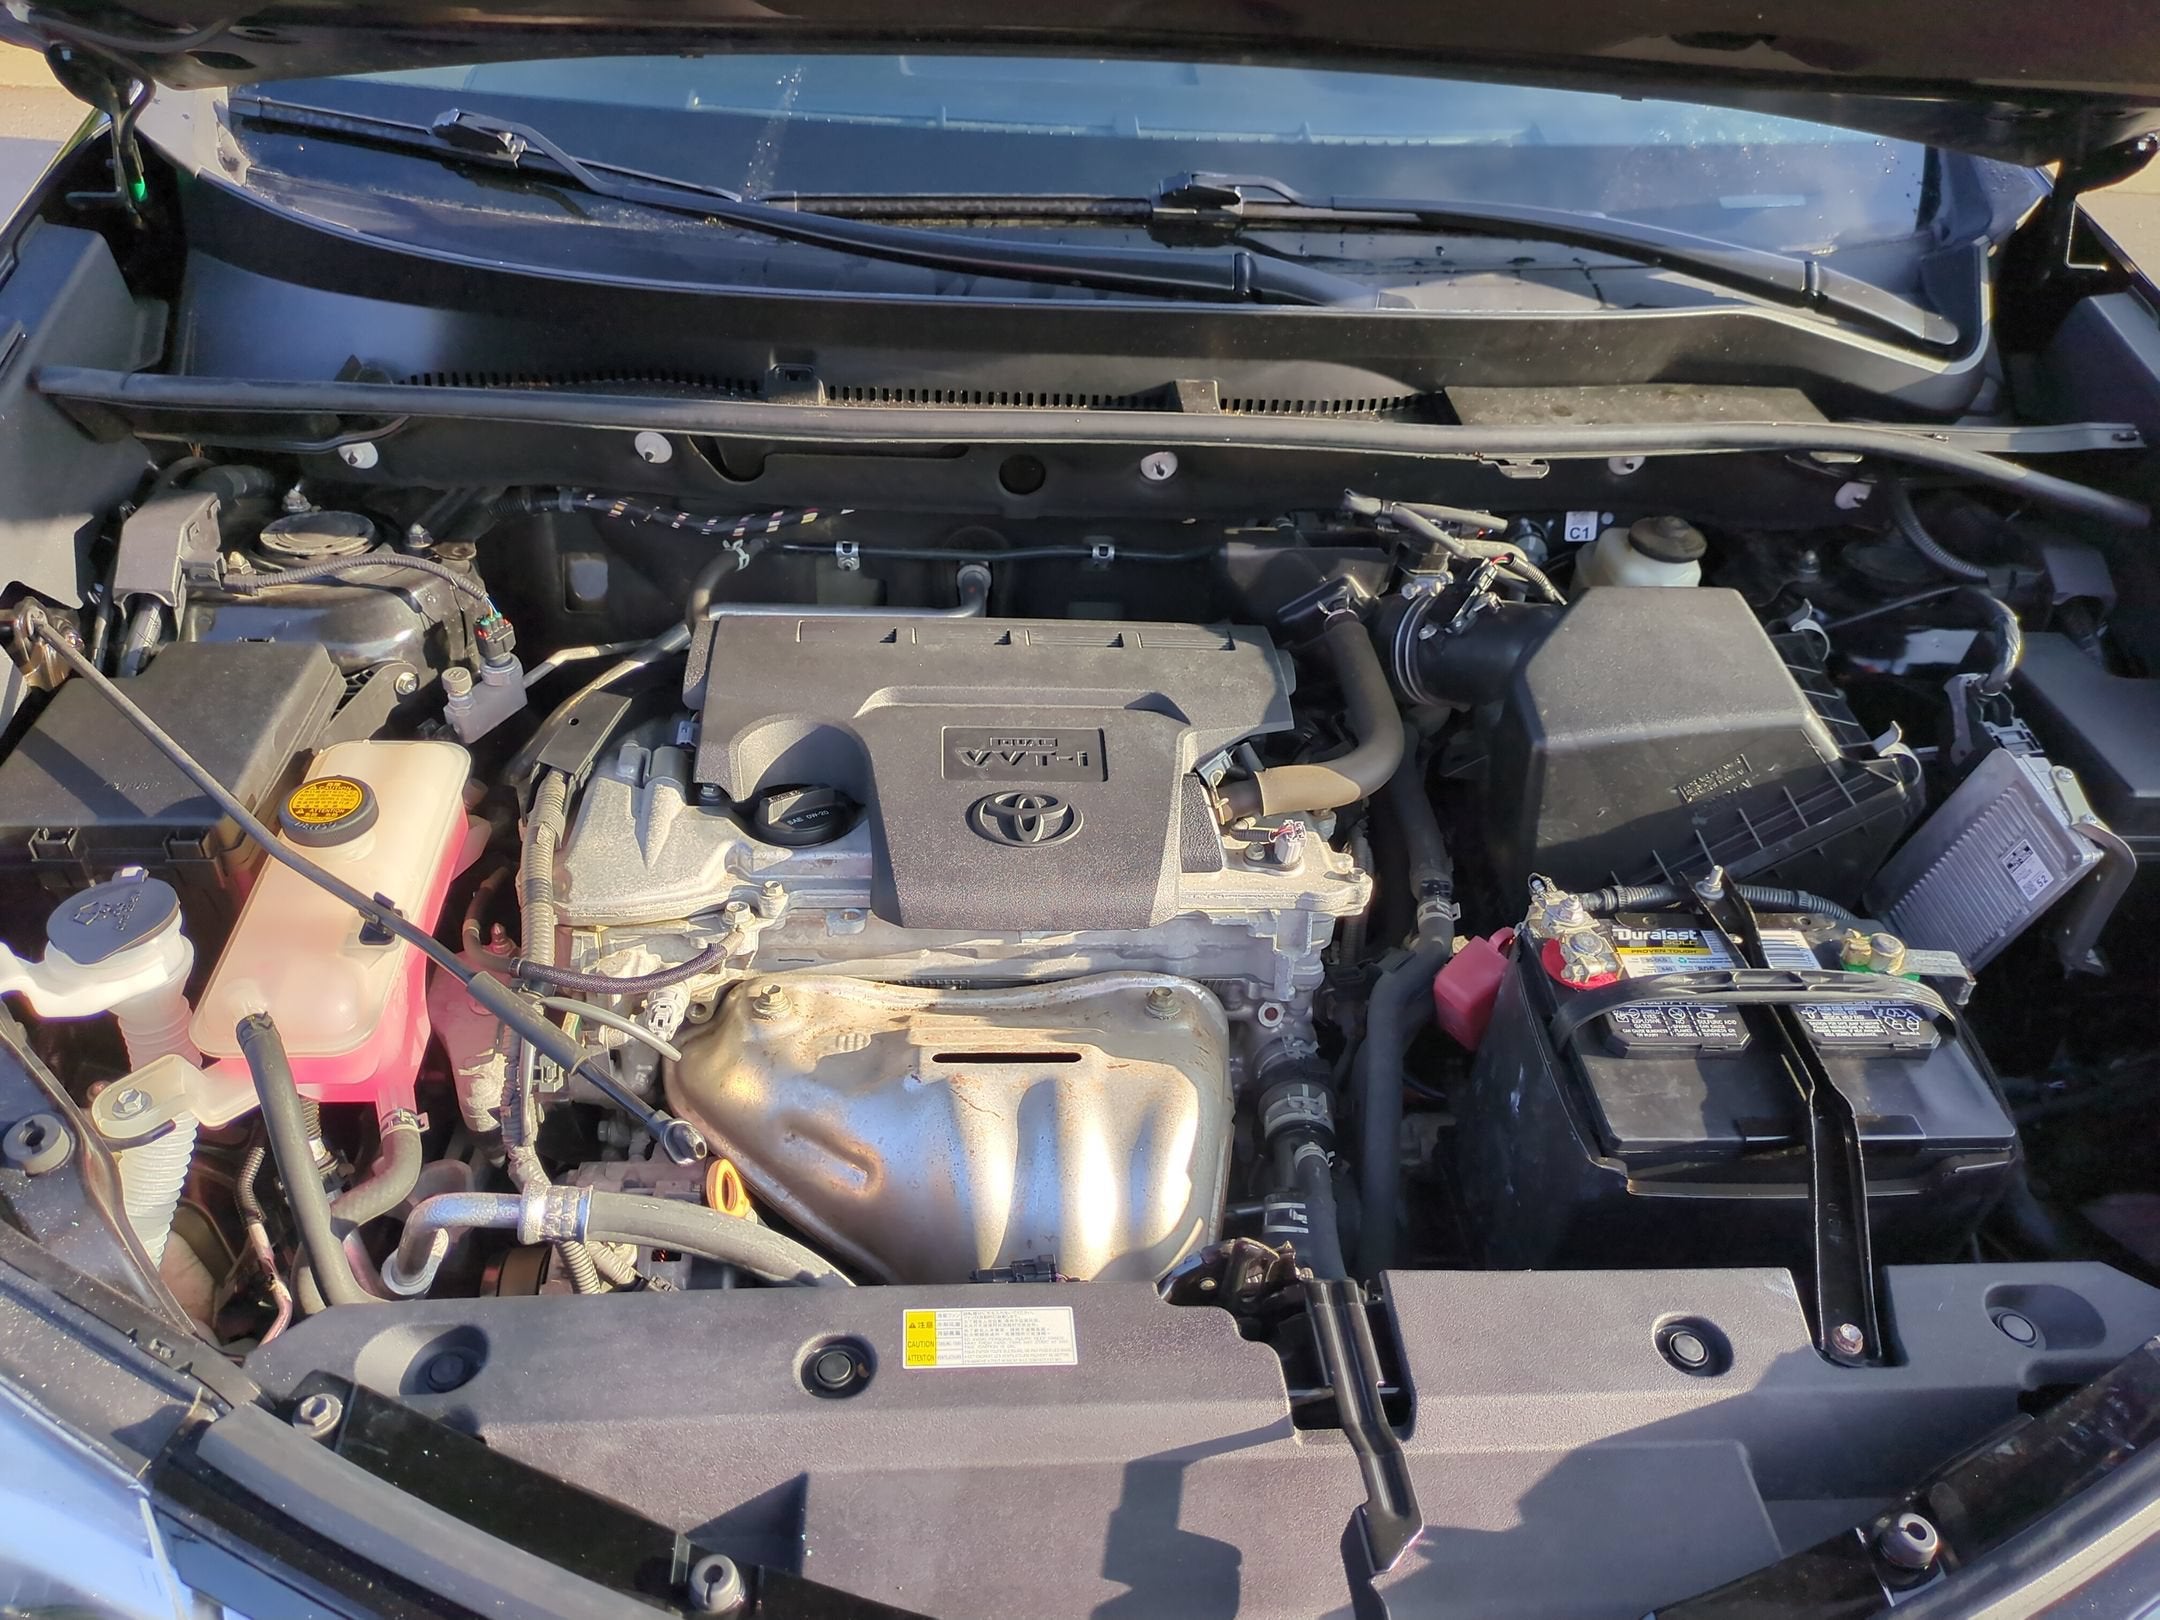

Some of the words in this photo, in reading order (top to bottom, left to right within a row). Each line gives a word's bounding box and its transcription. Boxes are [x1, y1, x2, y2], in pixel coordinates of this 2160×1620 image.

[1569, 527, 1590, 540] C1
[787, 817, 804, 825] SAE
[1612, 928, 1698, 940] Duralast
[917, 1321, 933, 1329] 注意
[907, 1340, 935, 1348] CAUTION
